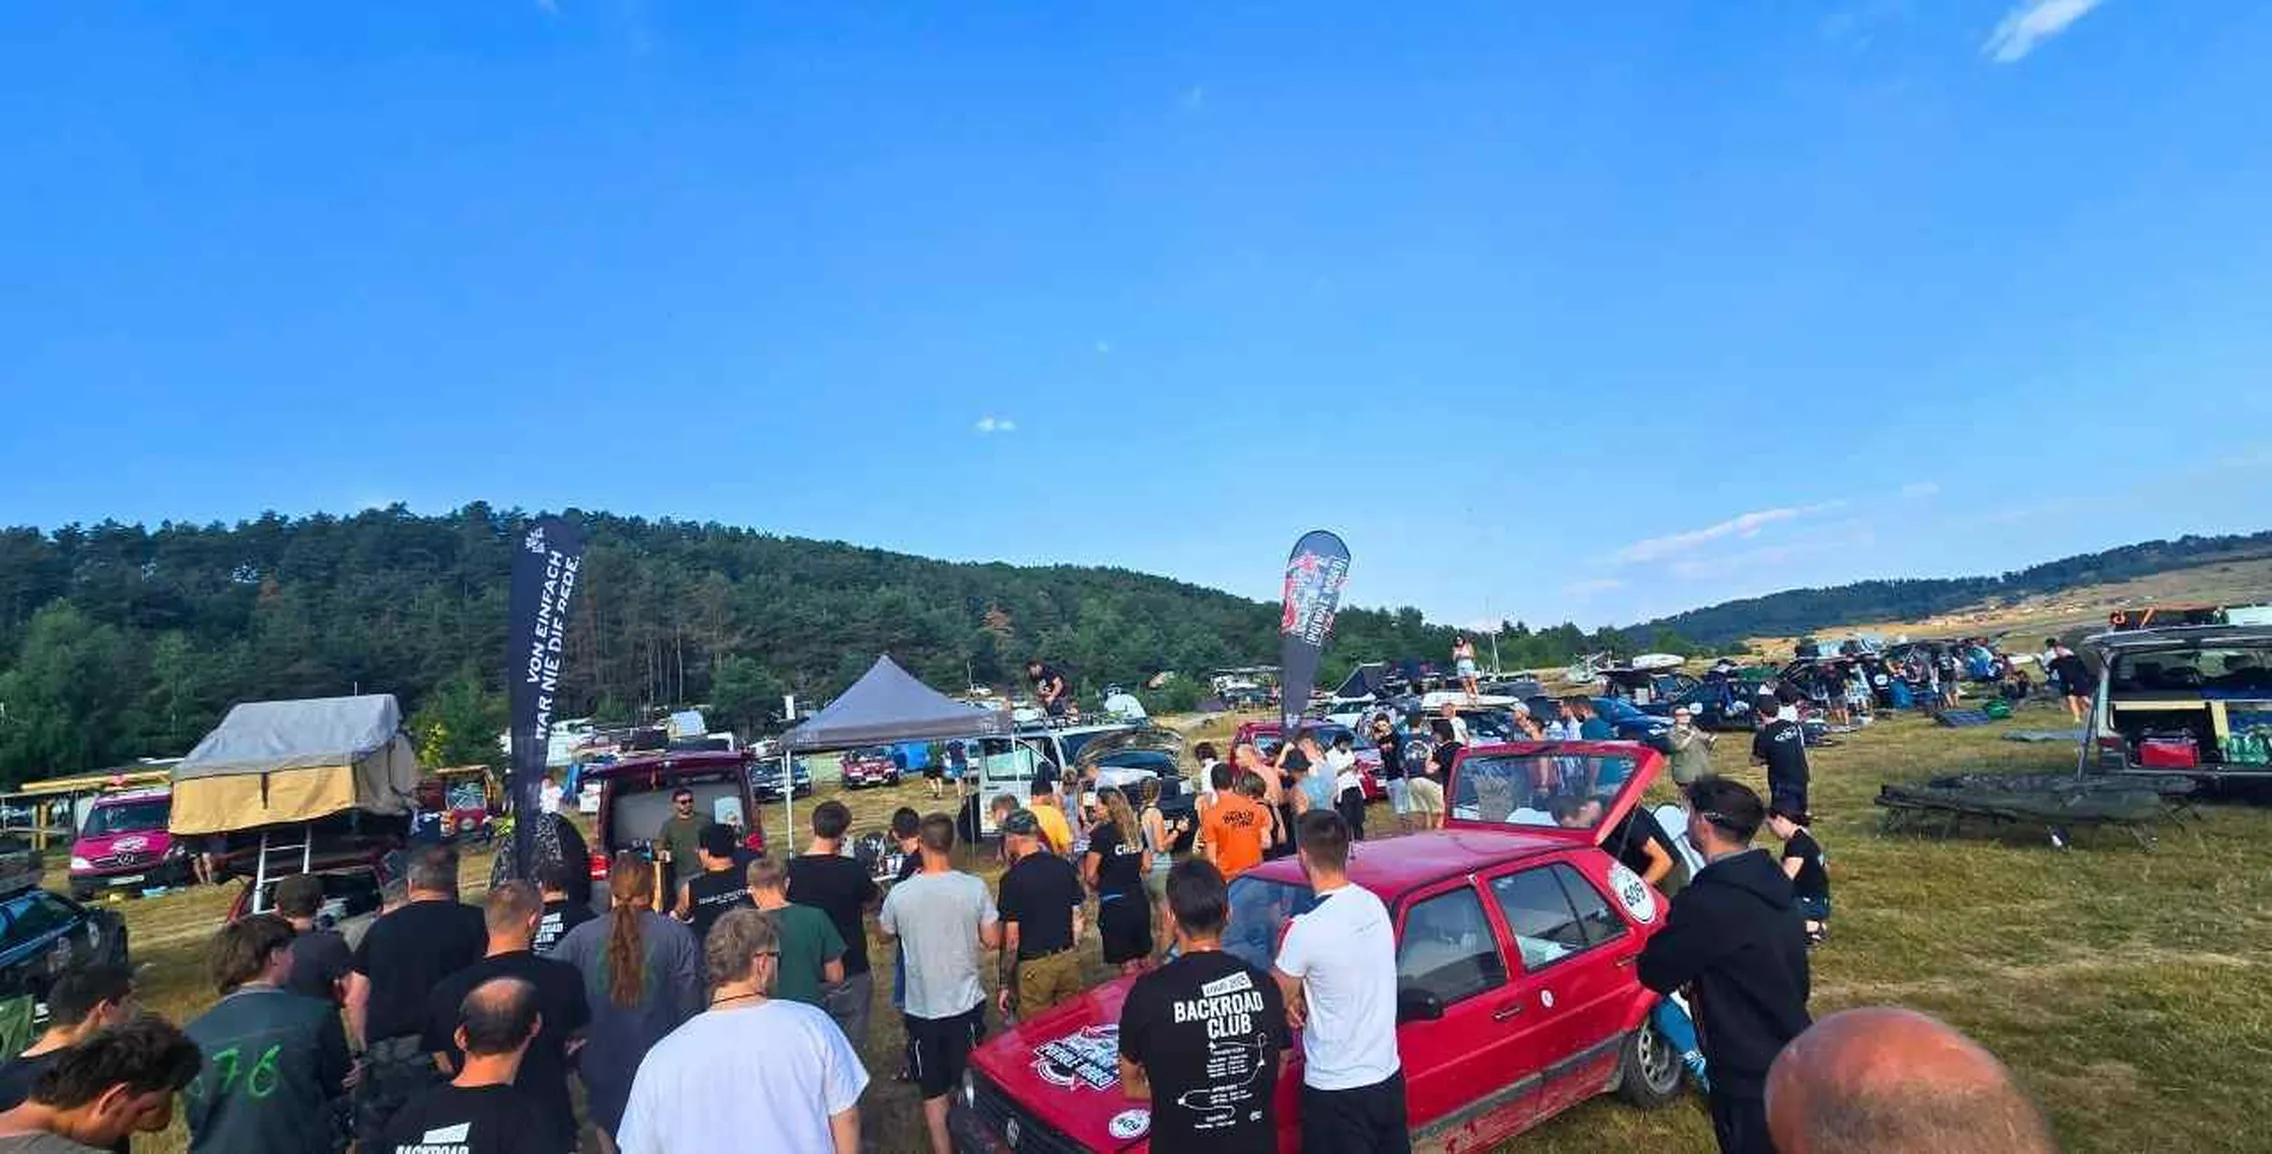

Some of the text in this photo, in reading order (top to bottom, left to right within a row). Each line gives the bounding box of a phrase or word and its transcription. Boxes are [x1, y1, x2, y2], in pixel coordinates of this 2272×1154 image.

[535, 550, 562, 638] EINFACH
[526, 642, 545, 683] VON
[541, 656, 560, 692] NIE
[1173, 991, 1265, 1024] BACKROAD
[1206, 1013, 1252, 1040] CLUB
